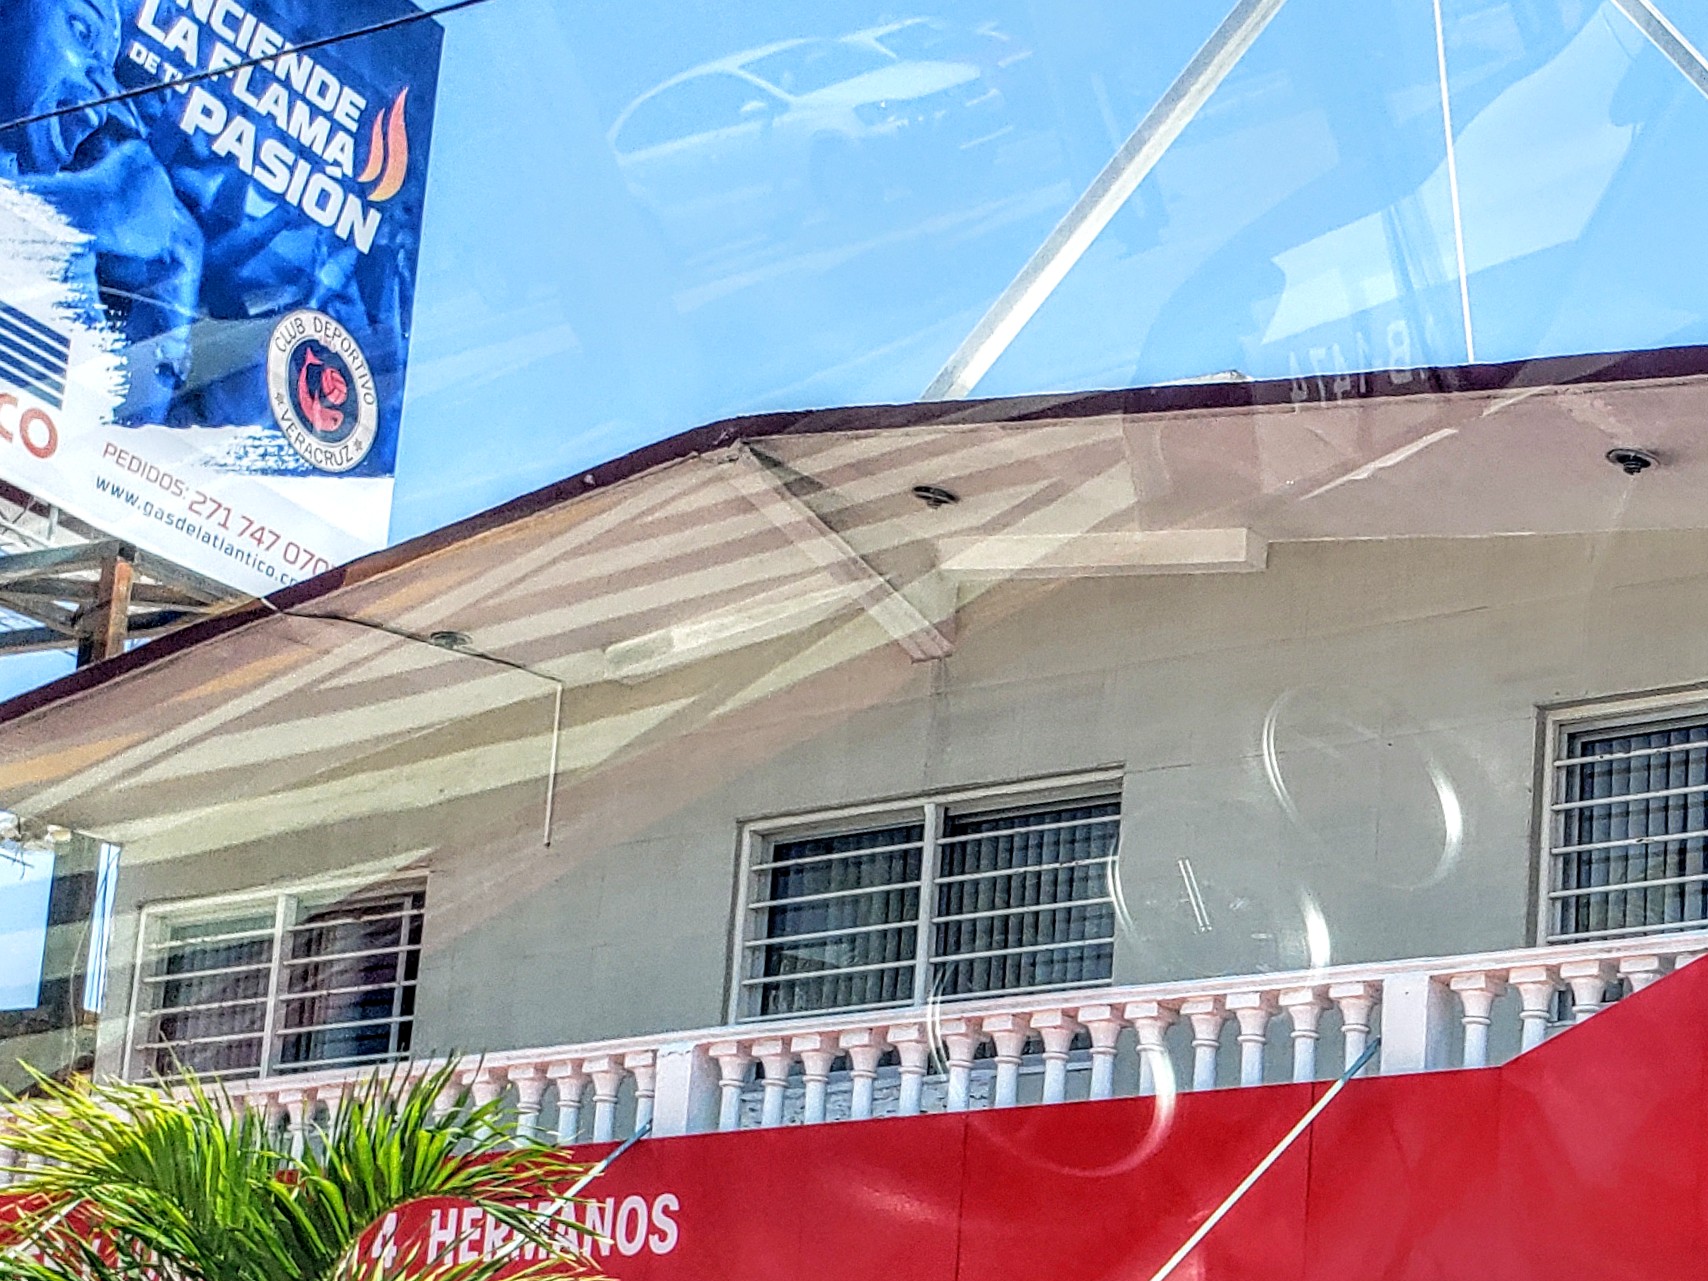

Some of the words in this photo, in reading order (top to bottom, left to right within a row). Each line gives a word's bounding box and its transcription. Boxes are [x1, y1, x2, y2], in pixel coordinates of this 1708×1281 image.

[129, 42, 162, 75] DE
[137, 0, 199, 68] LA
[208, 42, 355, 178] FLAMA
[179, 86, 382, 255] PASIÓN
[275, 316, 307, 354] CLUB
[312, 315, 376, 407] DEPORTIVO
[280, 409, 354, 467] VERACRUZ
[102, 441, 191, 501] PEDIDOS:
[187, 489, 233, 531] 271
[236, 514, 282, 549] 747
[282, 540, 340, 576] 070
[370, 1211, 398, 1269] 4
[426, 1192, 681, 1267] HERMANOS
